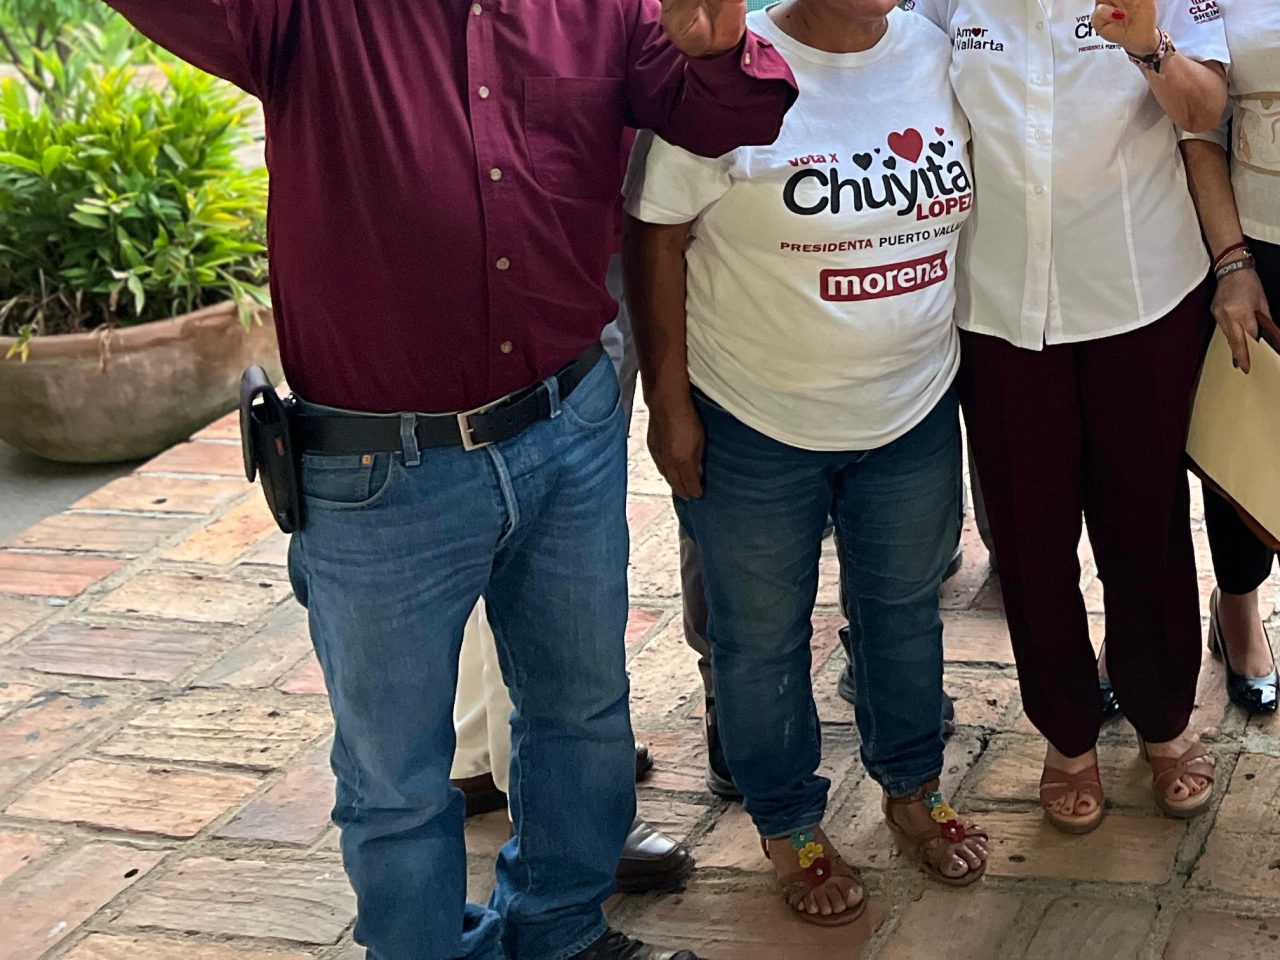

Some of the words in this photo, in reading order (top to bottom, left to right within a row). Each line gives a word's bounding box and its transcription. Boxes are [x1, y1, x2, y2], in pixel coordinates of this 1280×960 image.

[956, 38, 1004, 52] Vallarta
[783, 155, 971, 216] Chuyita
[780, 238, 874, 253] PRESIDENTA
[879, 230, 931, 248] PUERTO
[827, 258, 944, 296] morena
